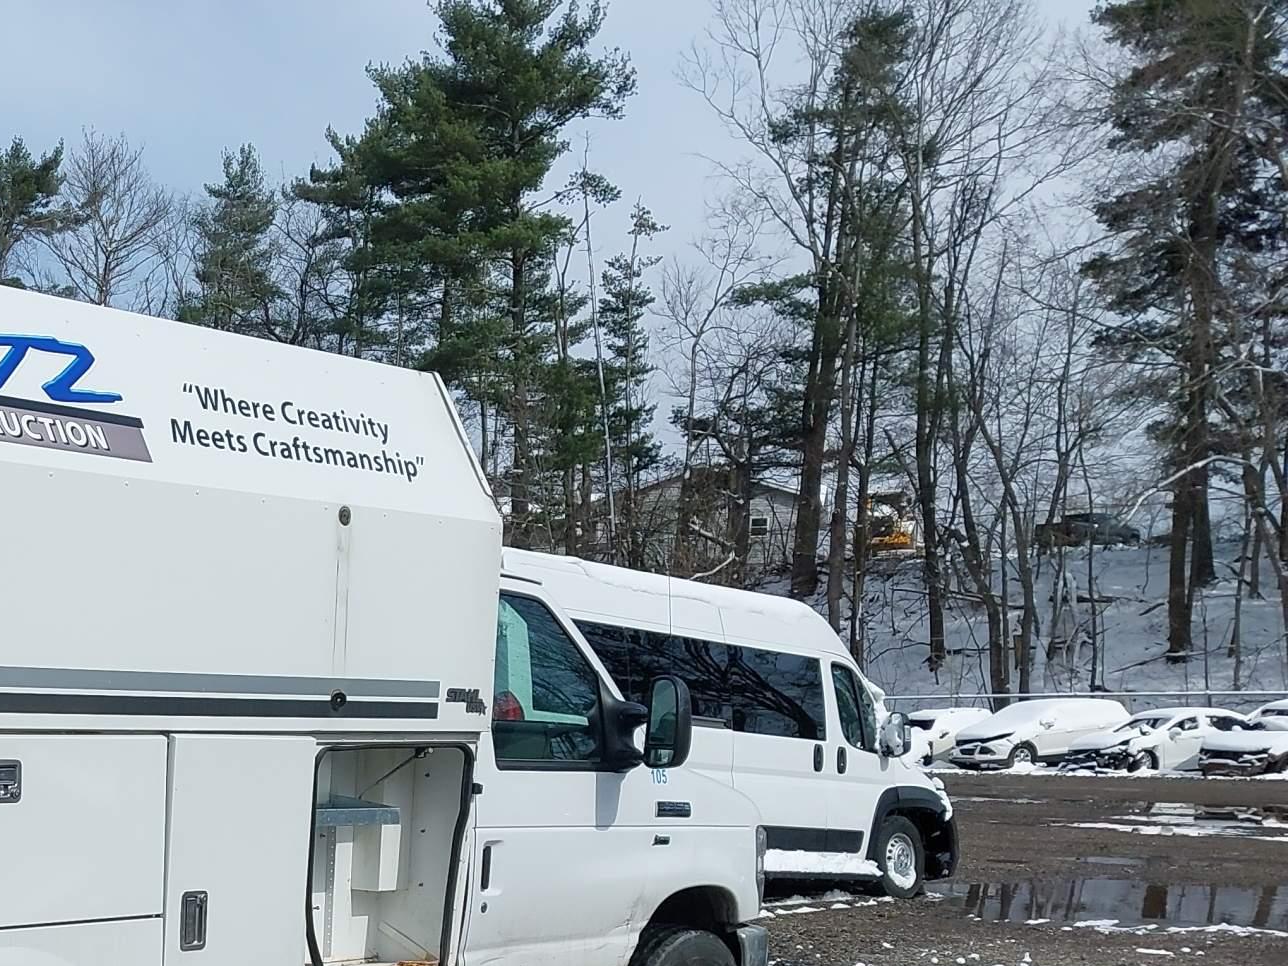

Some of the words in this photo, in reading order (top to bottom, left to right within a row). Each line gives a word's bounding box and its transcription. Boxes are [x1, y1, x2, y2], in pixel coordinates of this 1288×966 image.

[182, 382, 275, 421] “Where
[281, 401, 389, 445] Creativity
[171, 418, 247, 453] Meets
[253, 432, 424, 482] Craftsmanship”
[651, 768, 668, 784] 105
